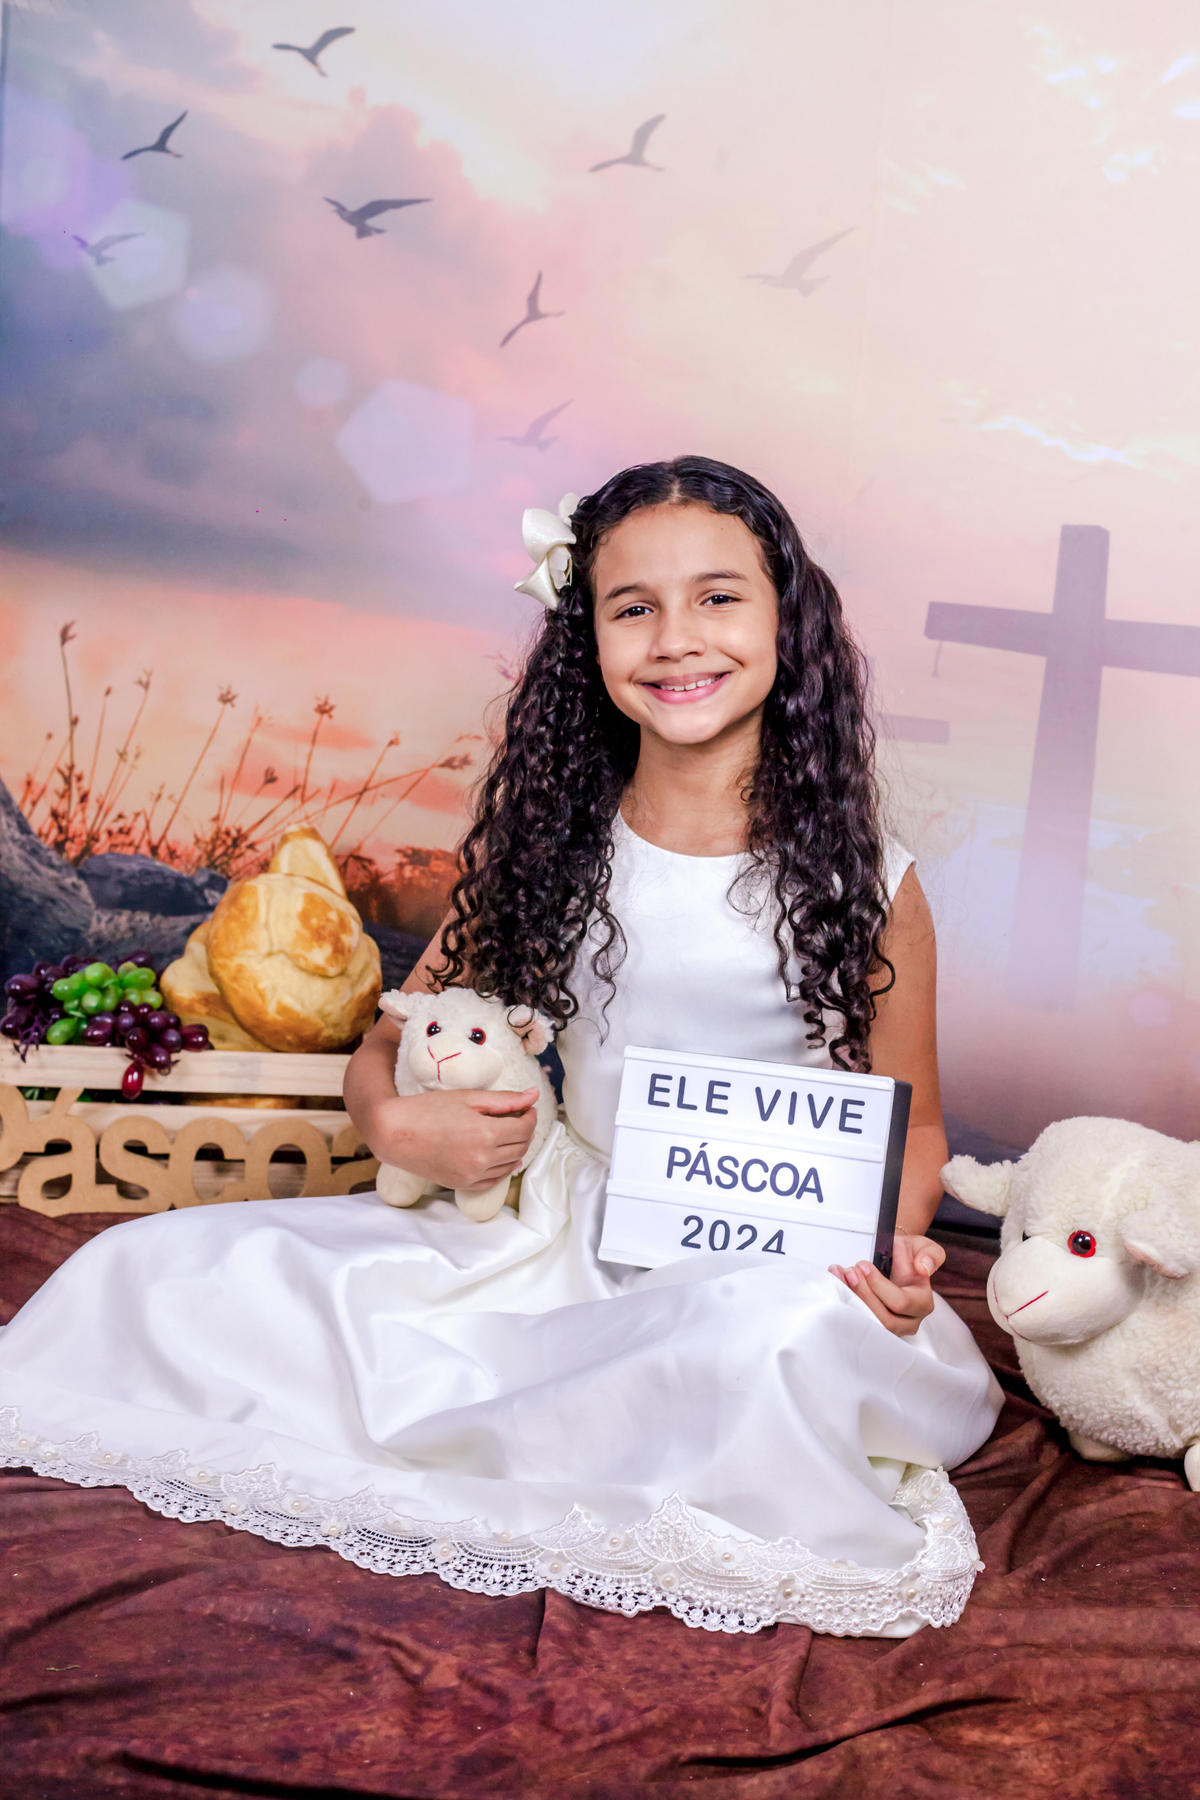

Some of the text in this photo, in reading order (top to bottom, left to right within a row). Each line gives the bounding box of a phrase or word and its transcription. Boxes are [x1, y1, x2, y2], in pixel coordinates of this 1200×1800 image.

[647, 1072, 866, 1135] ELE VIVE
[666, 1141, 824, 1204] PÁSCOA
[680, 1214, 786, 1255] 2024
